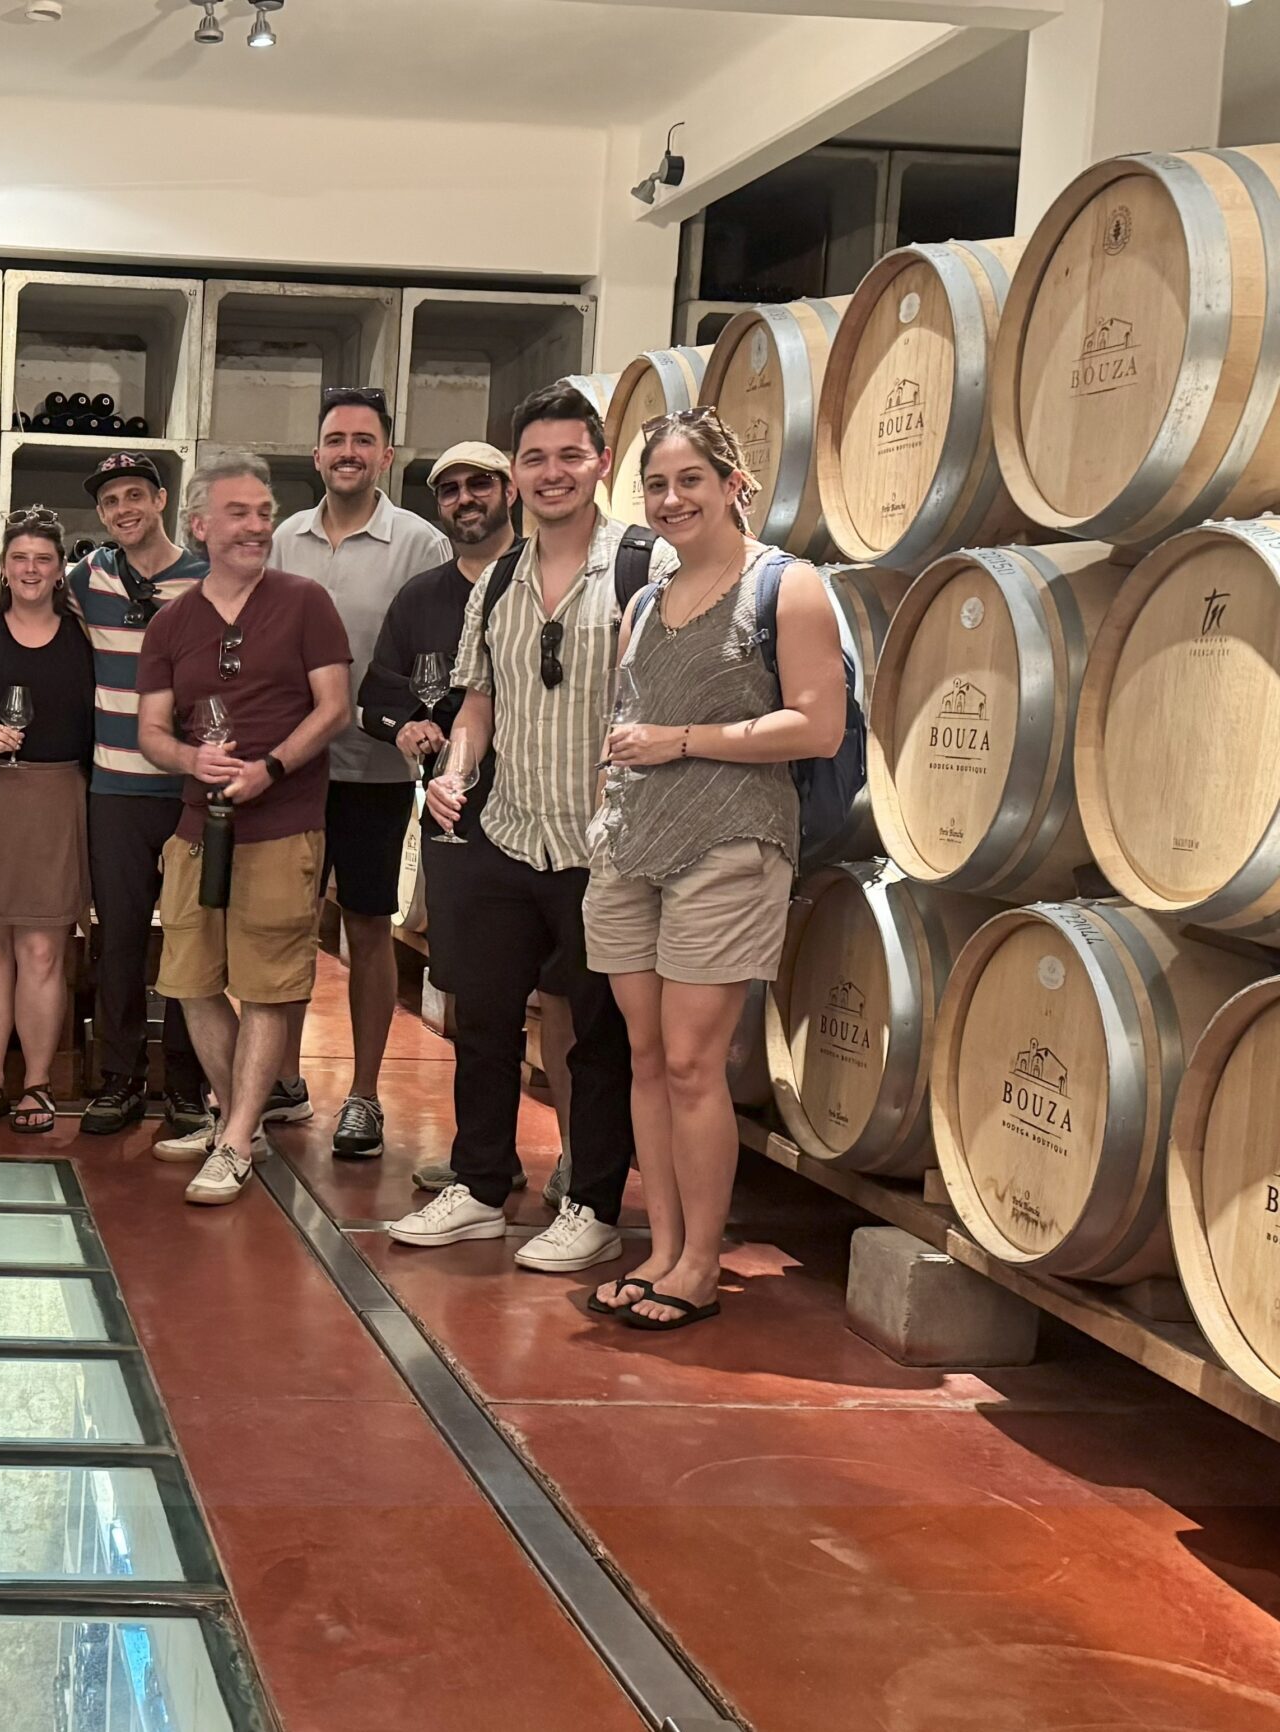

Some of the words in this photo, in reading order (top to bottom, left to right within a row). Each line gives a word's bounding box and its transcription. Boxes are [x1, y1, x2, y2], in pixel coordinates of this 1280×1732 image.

[1071, 355, 1138, 389] BOUZA
[878, 411, 924, 439] BOUZA
[929, 726, 990, 751] BOUZA
[929, 762, 954, 771] BODEGA
[956, 764, 987, 775] BOUTIQUE
[1059, 913, 1105, 946] 22044
[820, 1014, 870, 1049] BOUZA
[1001, 1080, 1072, 1133] BOUZA
[1002, 1119, 1029, 1138] BODEGA
[1032, 1133, 1068, 1157] BOUTIQUE
